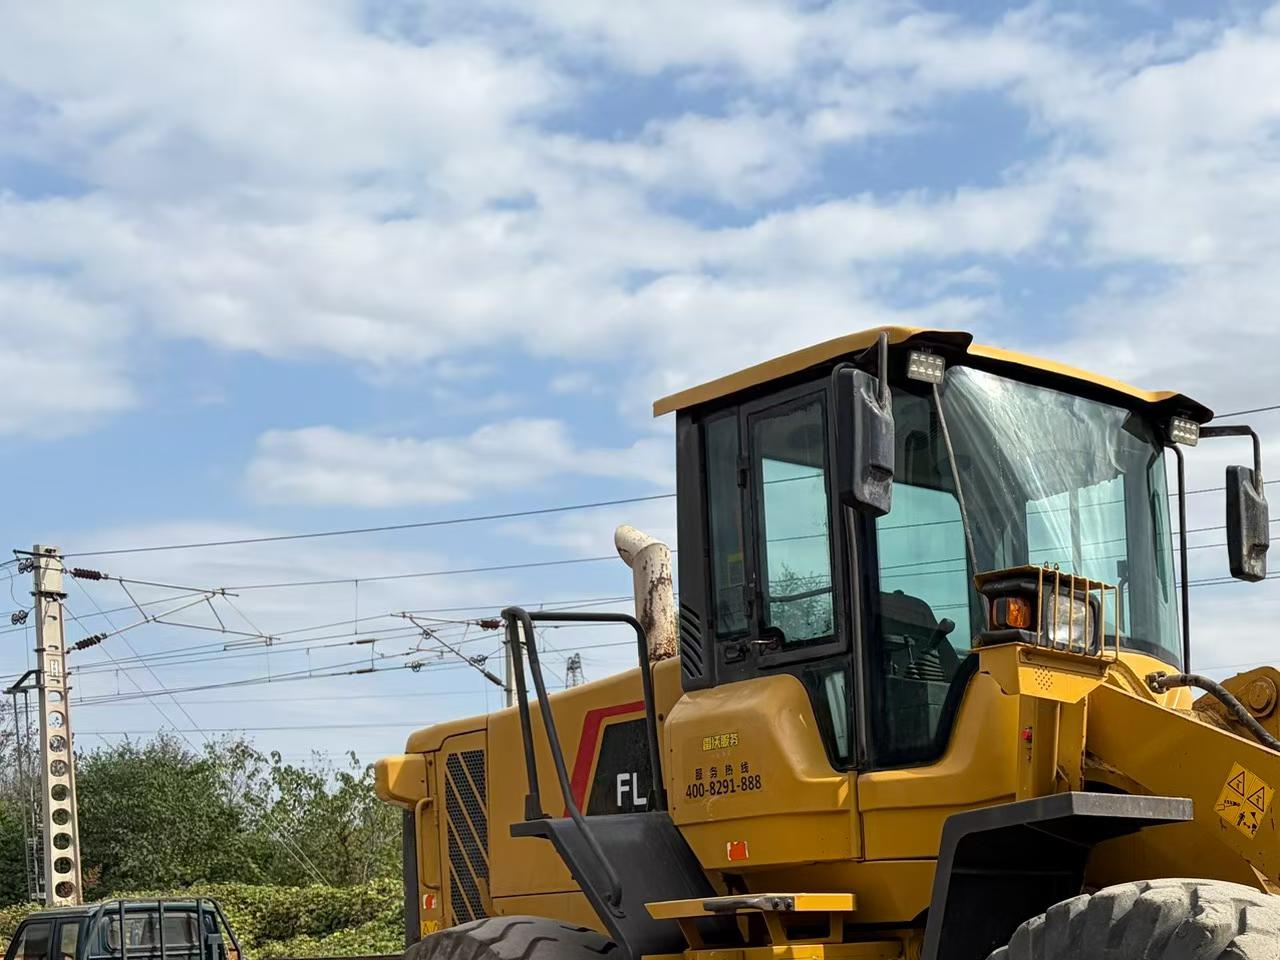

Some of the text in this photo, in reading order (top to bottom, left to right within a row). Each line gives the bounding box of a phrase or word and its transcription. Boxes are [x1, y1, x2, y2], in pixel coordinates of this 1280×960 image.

[695, 761, 750, 780] 服务热线
[685, 774, 762, 799] 400-8291-888
